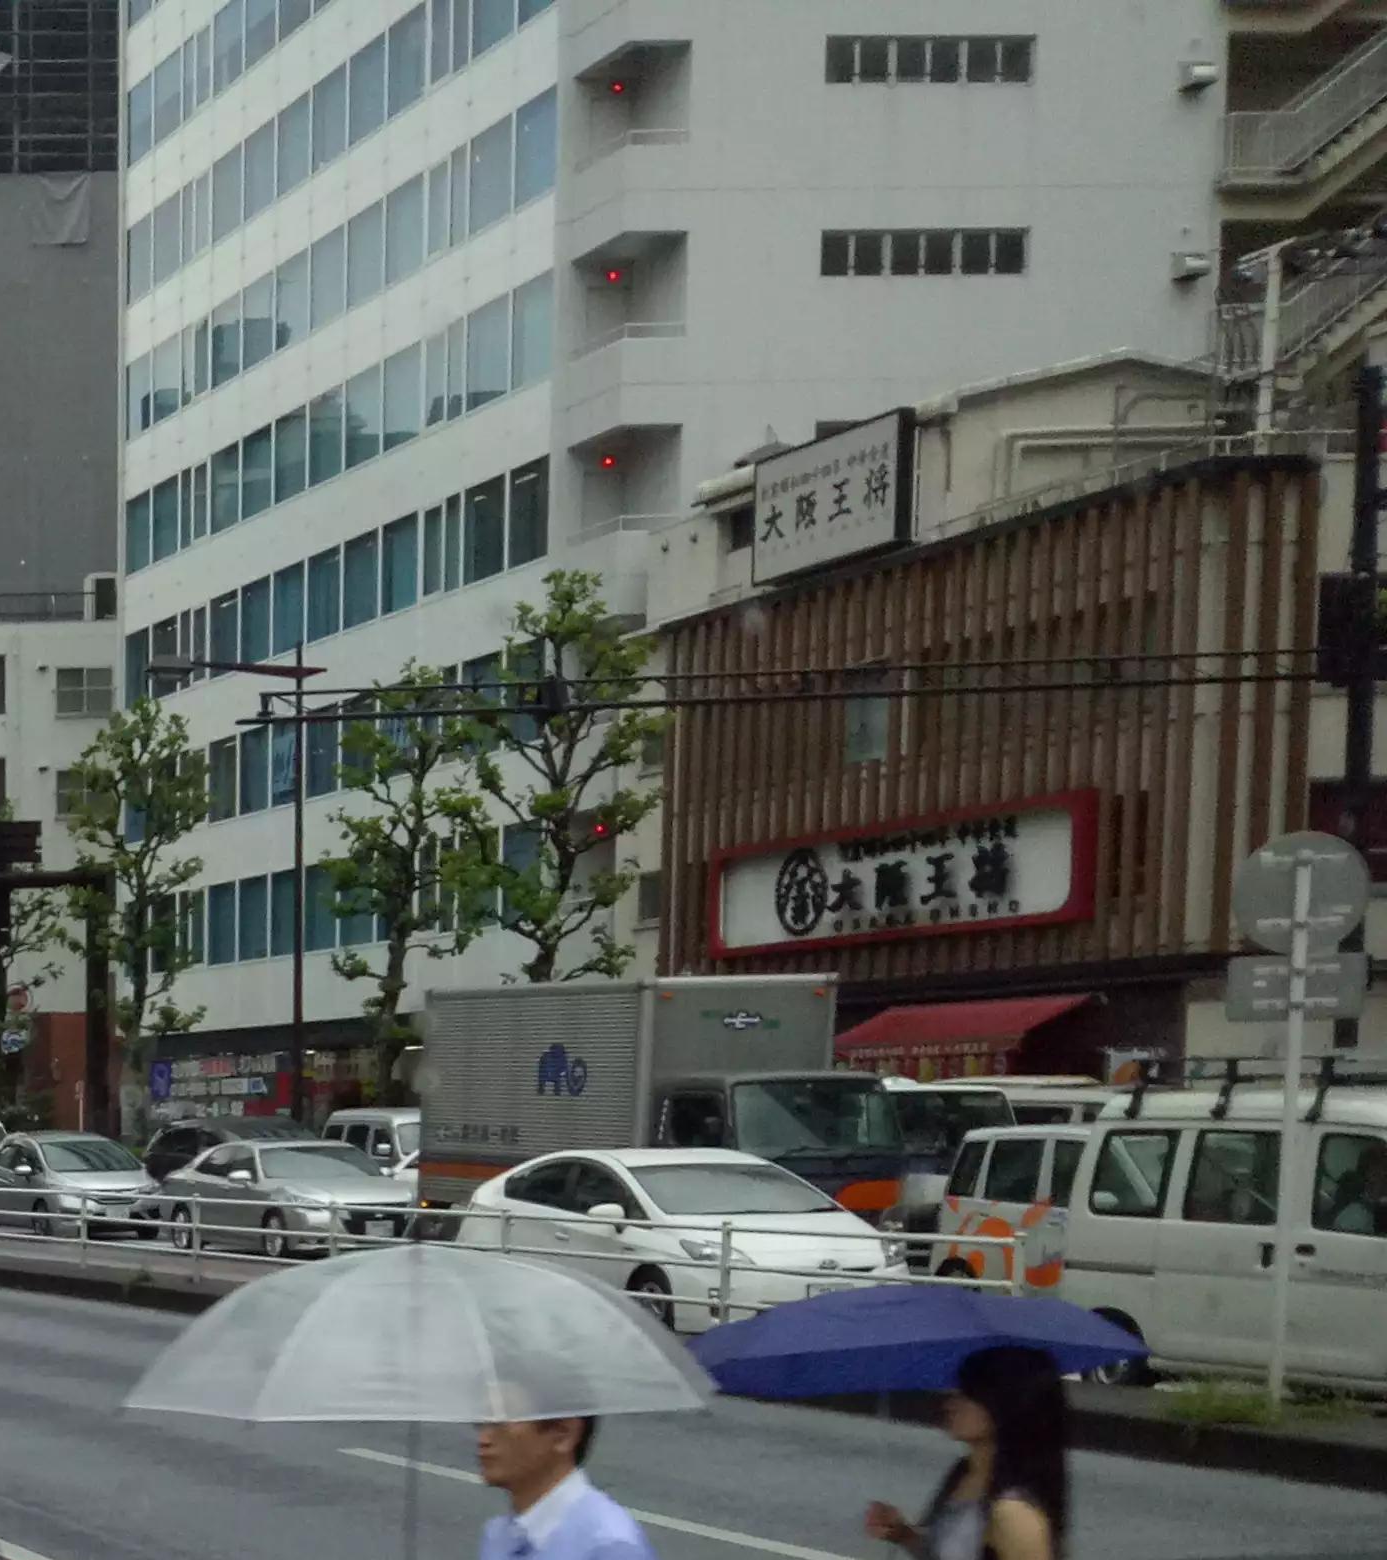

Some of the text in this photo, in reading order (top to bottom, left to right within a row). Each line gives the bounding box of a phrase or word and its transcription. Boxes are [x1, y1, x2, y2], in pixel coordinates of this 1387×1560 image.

[759, 463, 890, 543] 大阪王将
[827, 842, 1010, 912] 大阪王将
